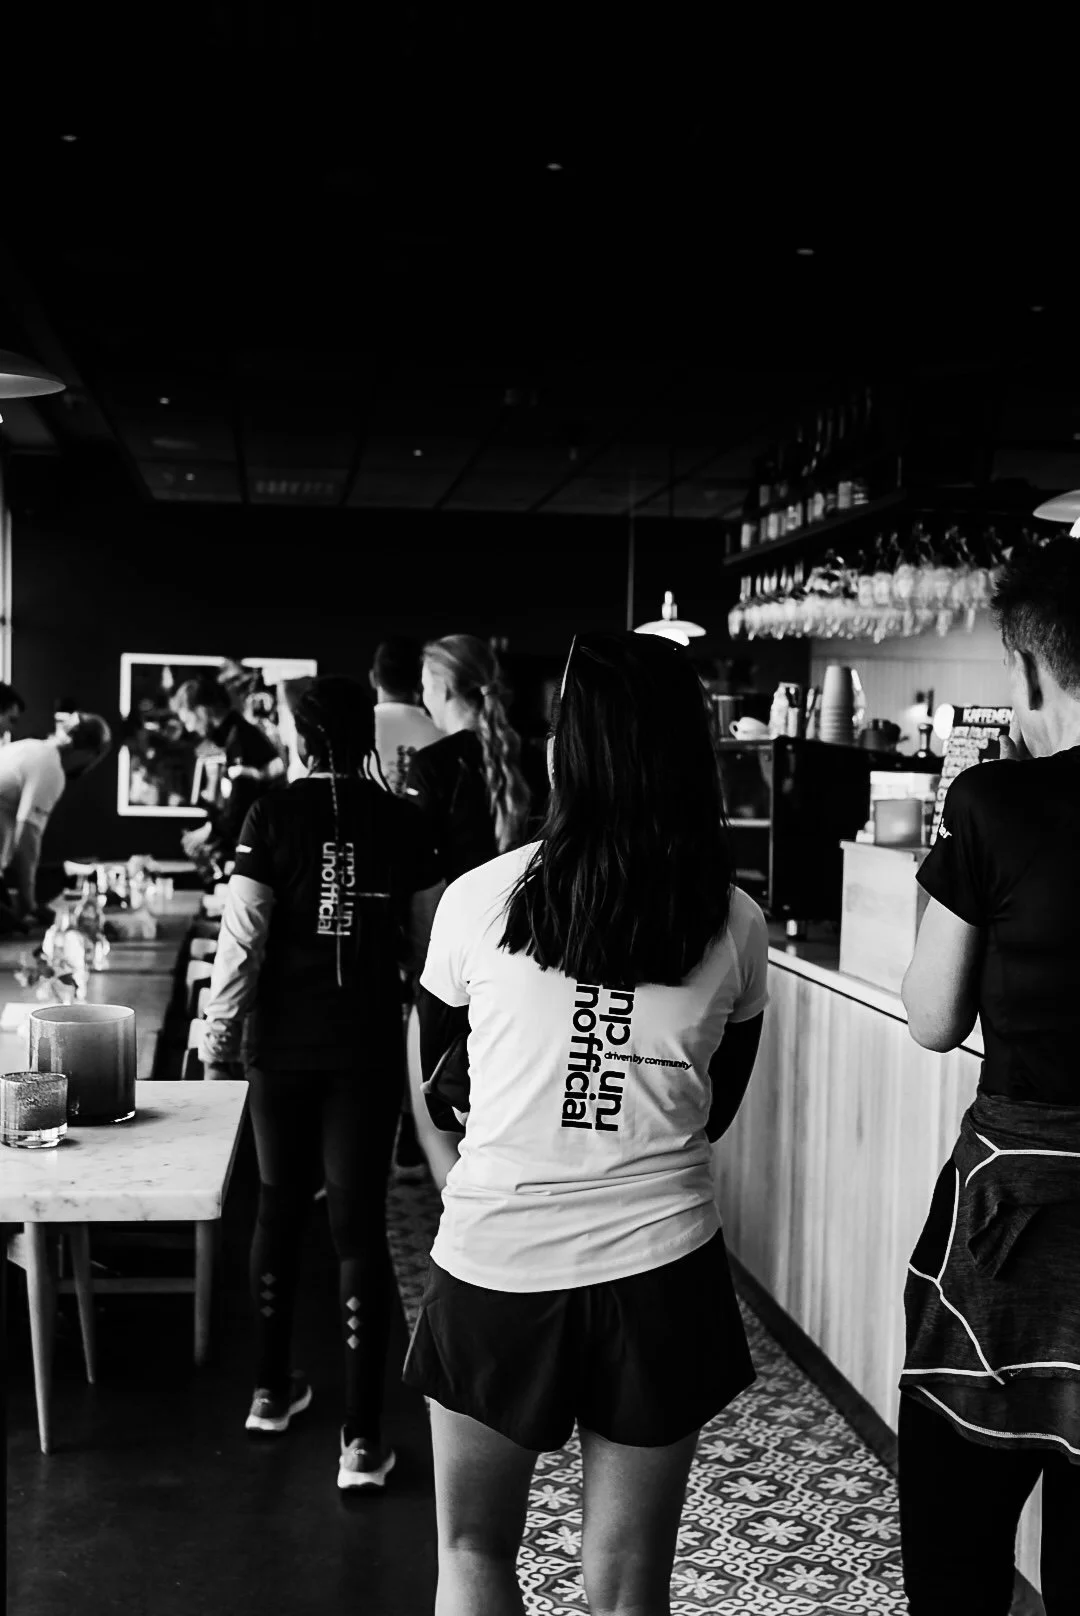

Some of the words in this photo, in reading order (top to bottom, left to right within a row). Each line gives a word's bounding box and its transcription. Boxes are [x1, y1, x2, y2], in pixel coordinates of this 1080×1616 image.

[317, 841, 340, 935] unofficial
[645, 1057, 692, 1070] community
[595, 1070, 626, 1132] run
